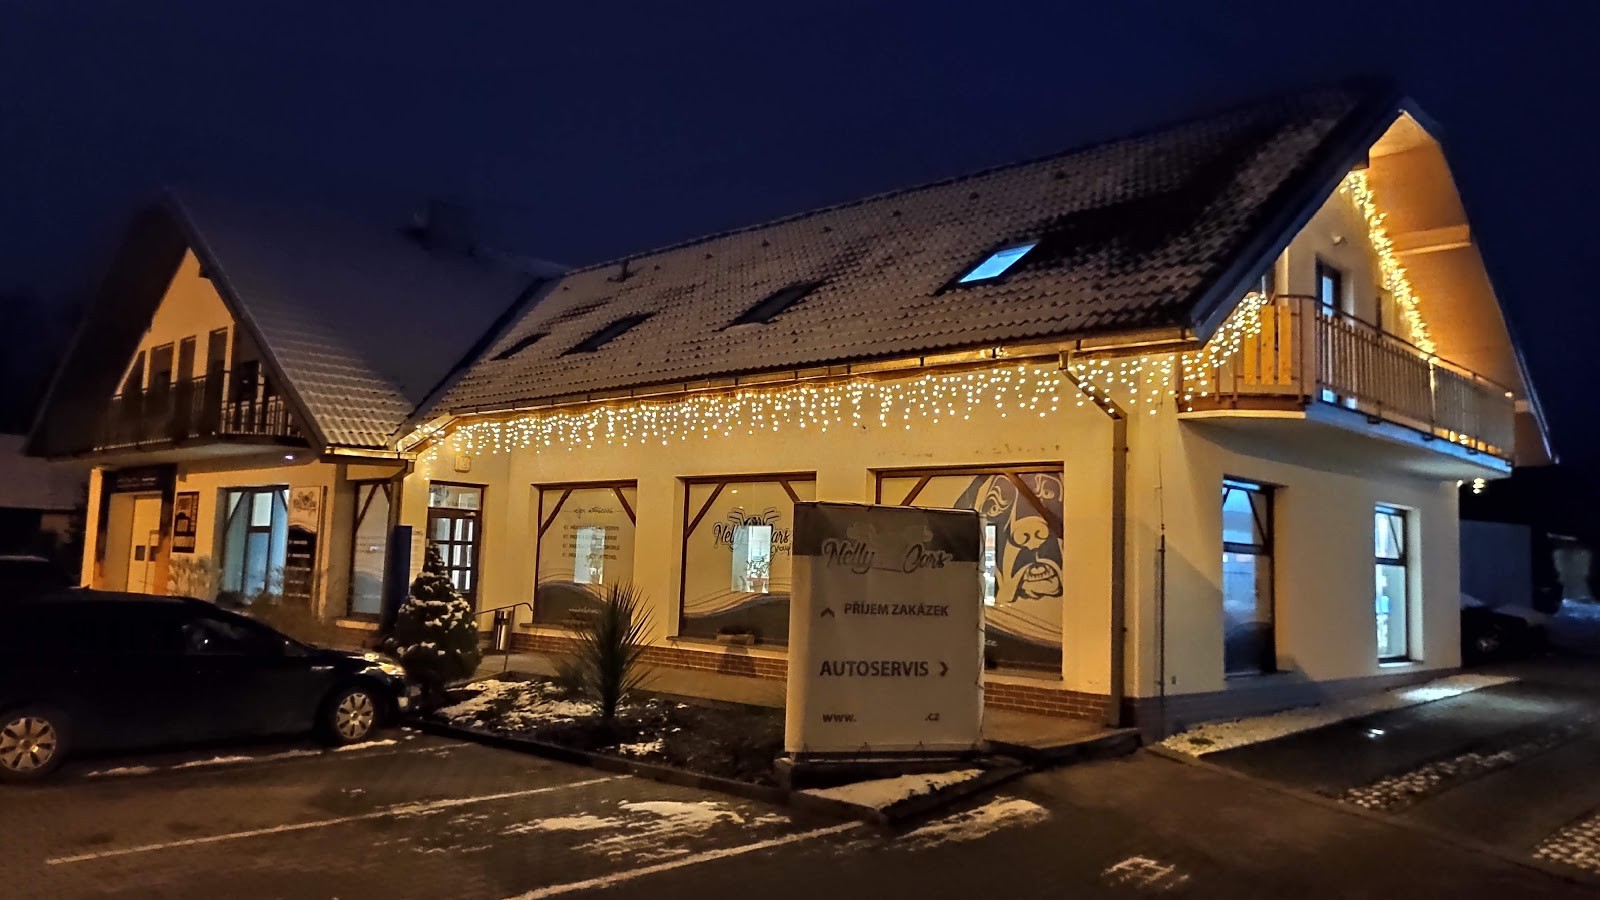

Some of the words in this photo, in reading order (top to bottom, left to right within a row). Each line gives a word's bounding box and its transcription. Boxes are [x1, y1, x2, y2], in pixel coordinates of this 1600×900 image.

[823, 540, 875, 575] Nelly
[902, 543, 948, 574] Cars
[843, 601, 889, 616] PŘÍJEM
[891, 602, 950, 617] ZAKÁZEK
[819, 660, 929, 677] AUTOSERVIS
[822, 714, 857, 723] www.
[925, 712, 940, 722] .cz
